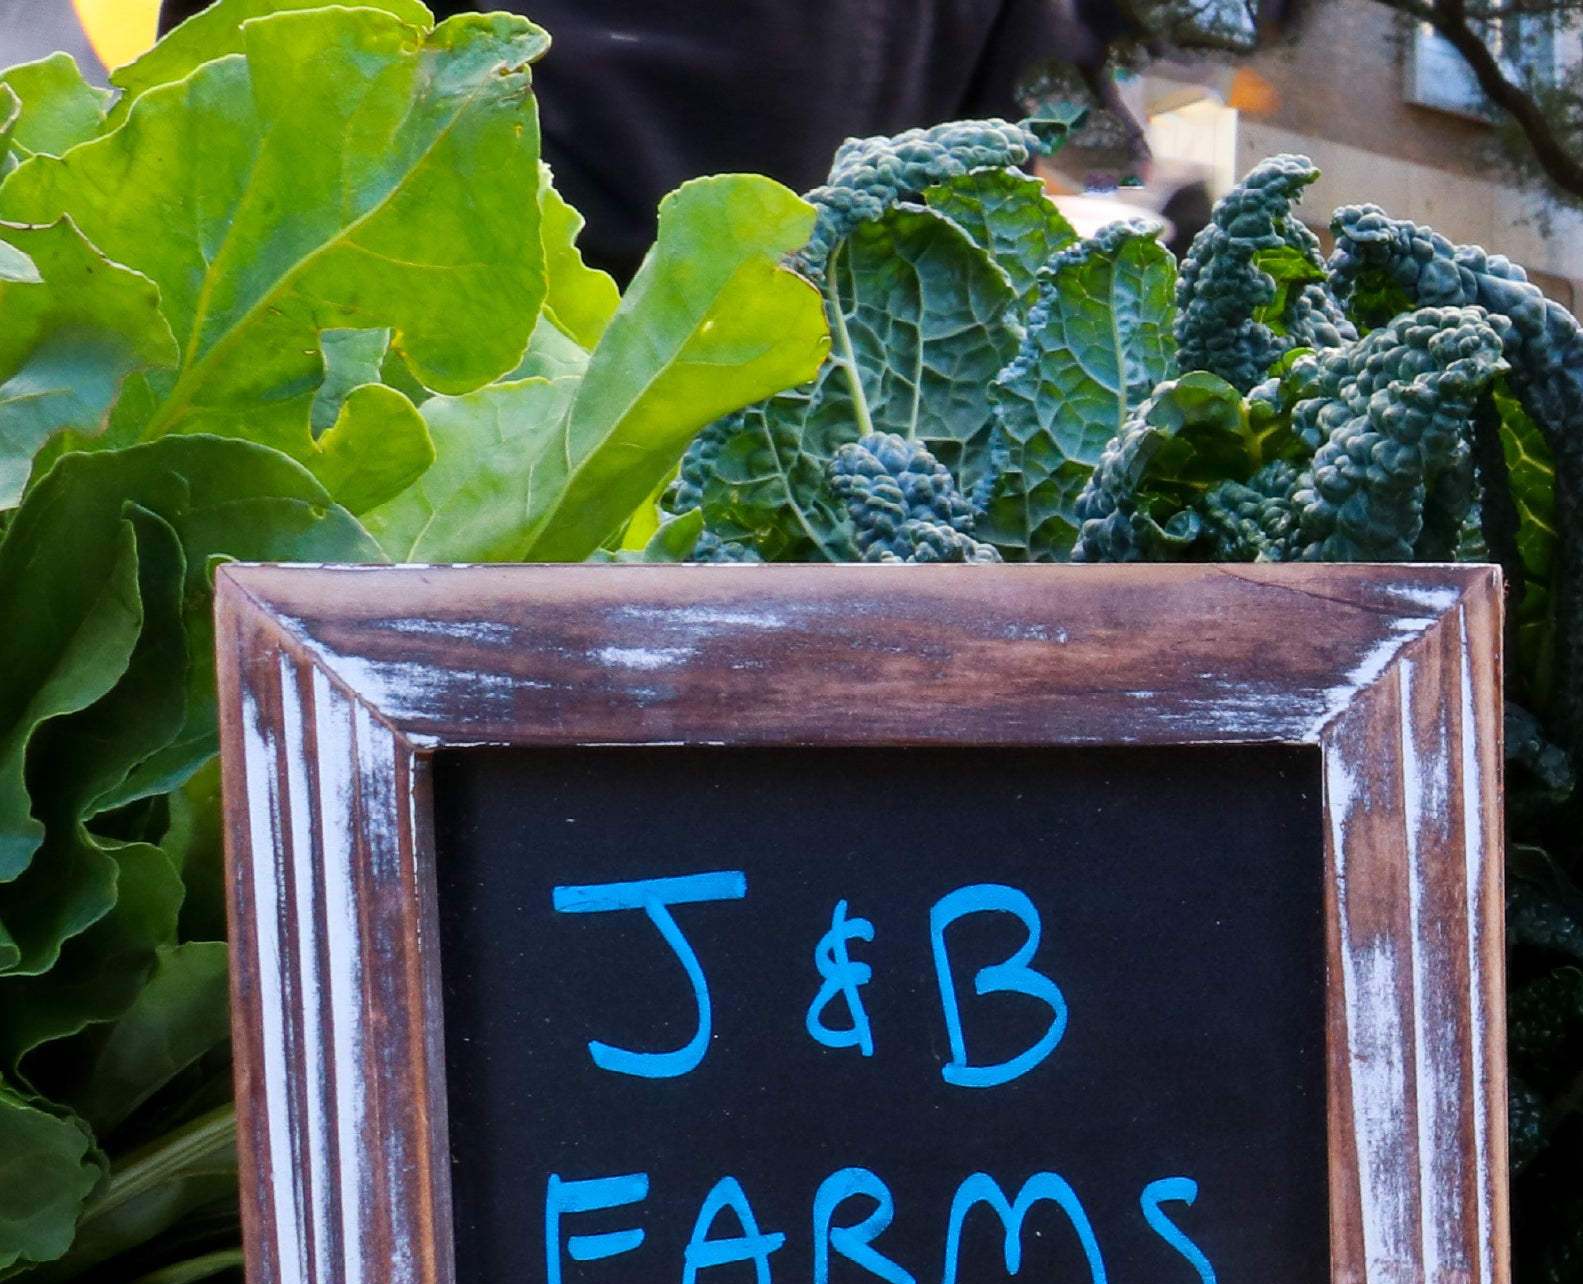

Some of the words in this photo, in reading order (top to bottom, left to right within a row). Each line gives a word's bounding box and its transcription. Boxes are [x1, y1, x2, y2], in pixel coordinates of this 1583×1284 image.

[552, 870, 748, 1078] J
[805, 899, 875, 1057] &
[930, 882, 1068, 1088] B
